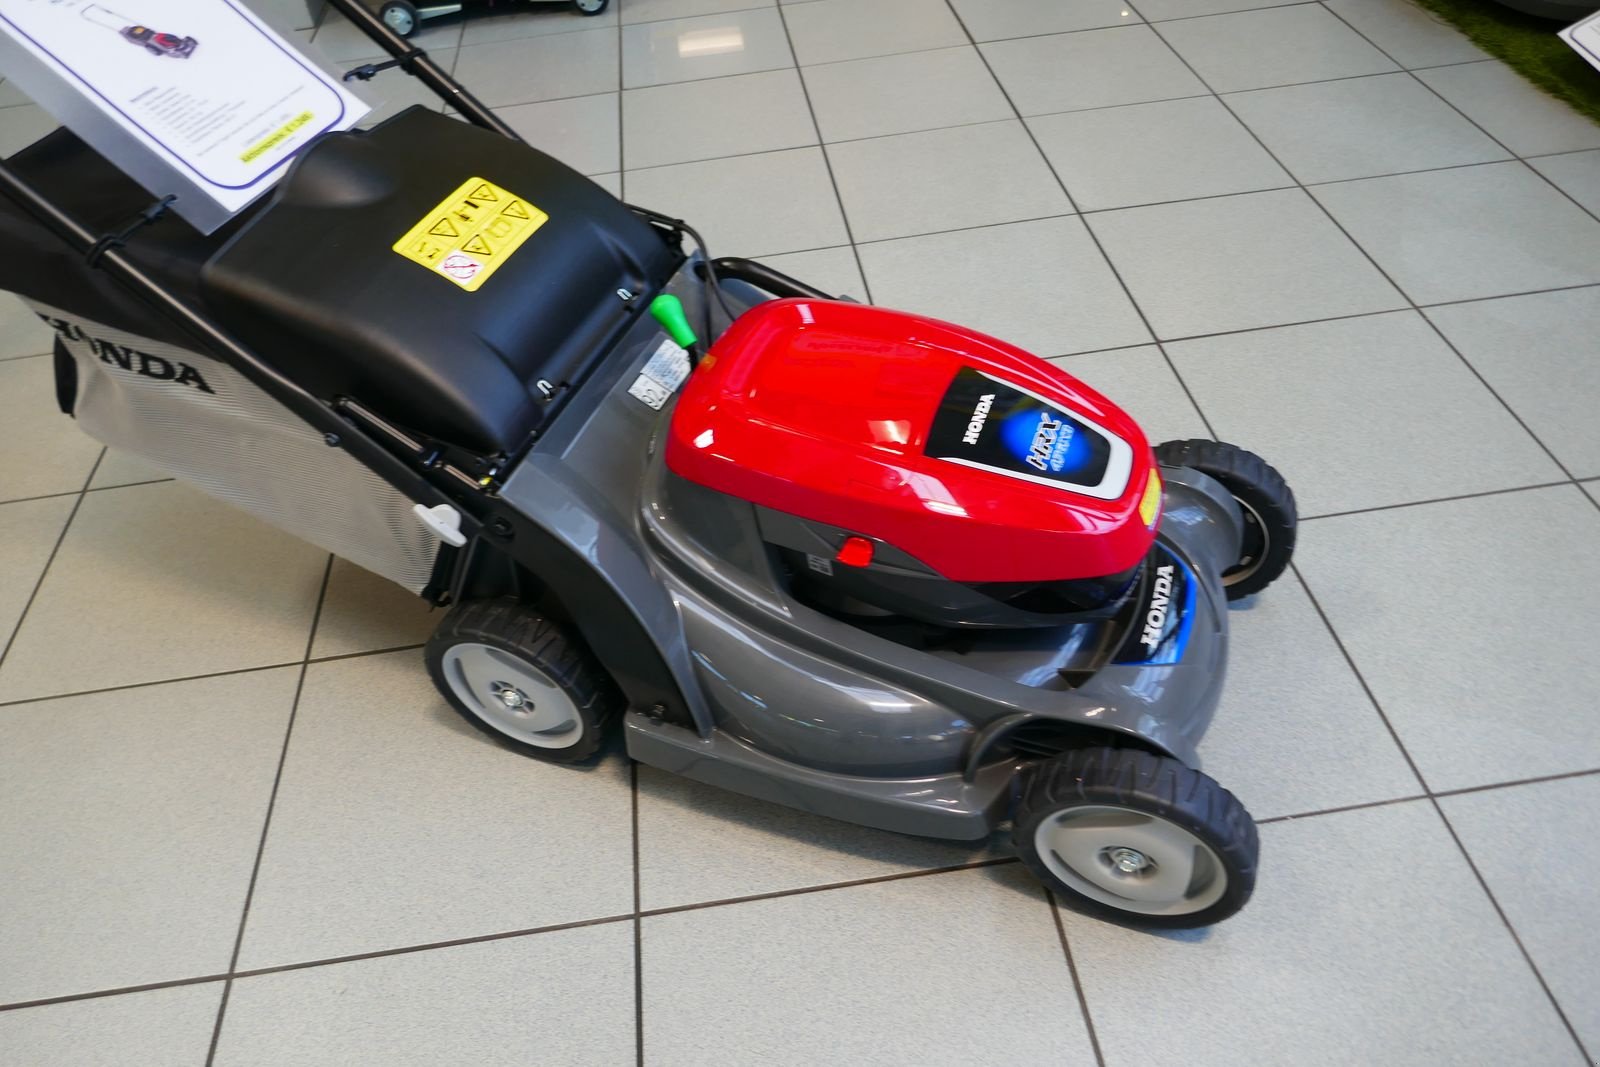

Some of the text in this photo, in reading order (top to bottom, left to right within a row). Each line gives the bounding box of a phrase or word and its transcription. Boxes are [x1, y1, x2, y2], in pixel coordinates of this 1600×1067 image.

[962, 393, 996, 446] HONDA
[1025, 412, 1062, 471] HRX
[1140, 565, 1174, 649] HONDA
